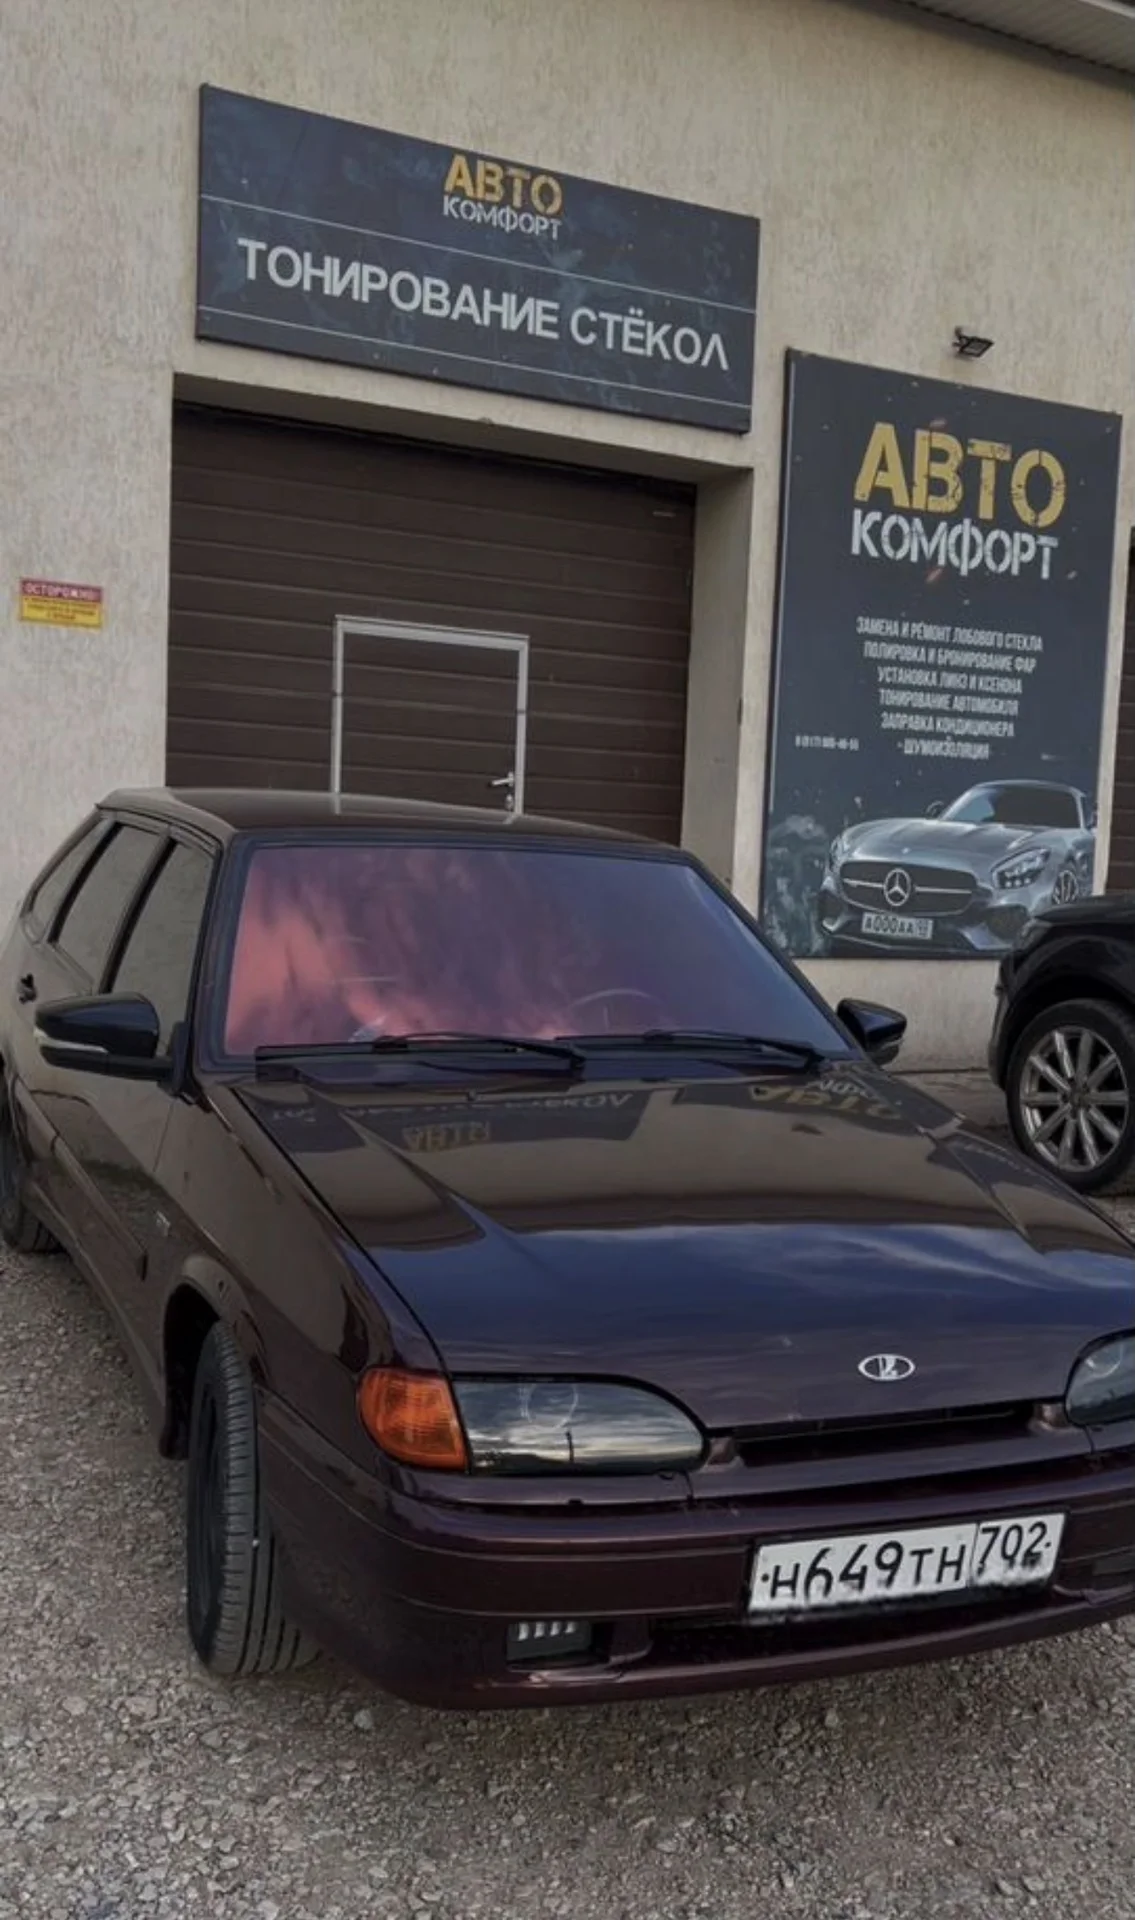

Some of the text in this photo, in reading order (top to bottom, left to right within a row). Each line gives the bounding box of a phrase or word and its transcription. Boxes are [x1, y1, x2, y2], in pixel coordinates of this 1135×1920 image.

[444, 154, 563, 215] АВТО
[443, 194, 562, 240] КОМФОРТ
[237, 237, 729, 371] ТОНИРОВАНИЕ СТЁКОЛ
[853, 421, 1066, 528] АВТО
[851, 507, 1059, 580] КОМФОРТ
[856, 616, 1044, 652] ЗАМЕНА И РЕМОНТ ЛОБОВОГО СТЕКЛА
[863, 641, 926, 663] ПОЛИРОВКА
[1014, 656, 1036, 673] ФАР
[877, 666, 937, 687] УСТАНОВКА
[978, 675, 1023, 694] КСЕНОНА
[881, 711, 934, 732] ЗАПРАВКА
[770, 1521, 1048, 1598] Н649ТН 702
